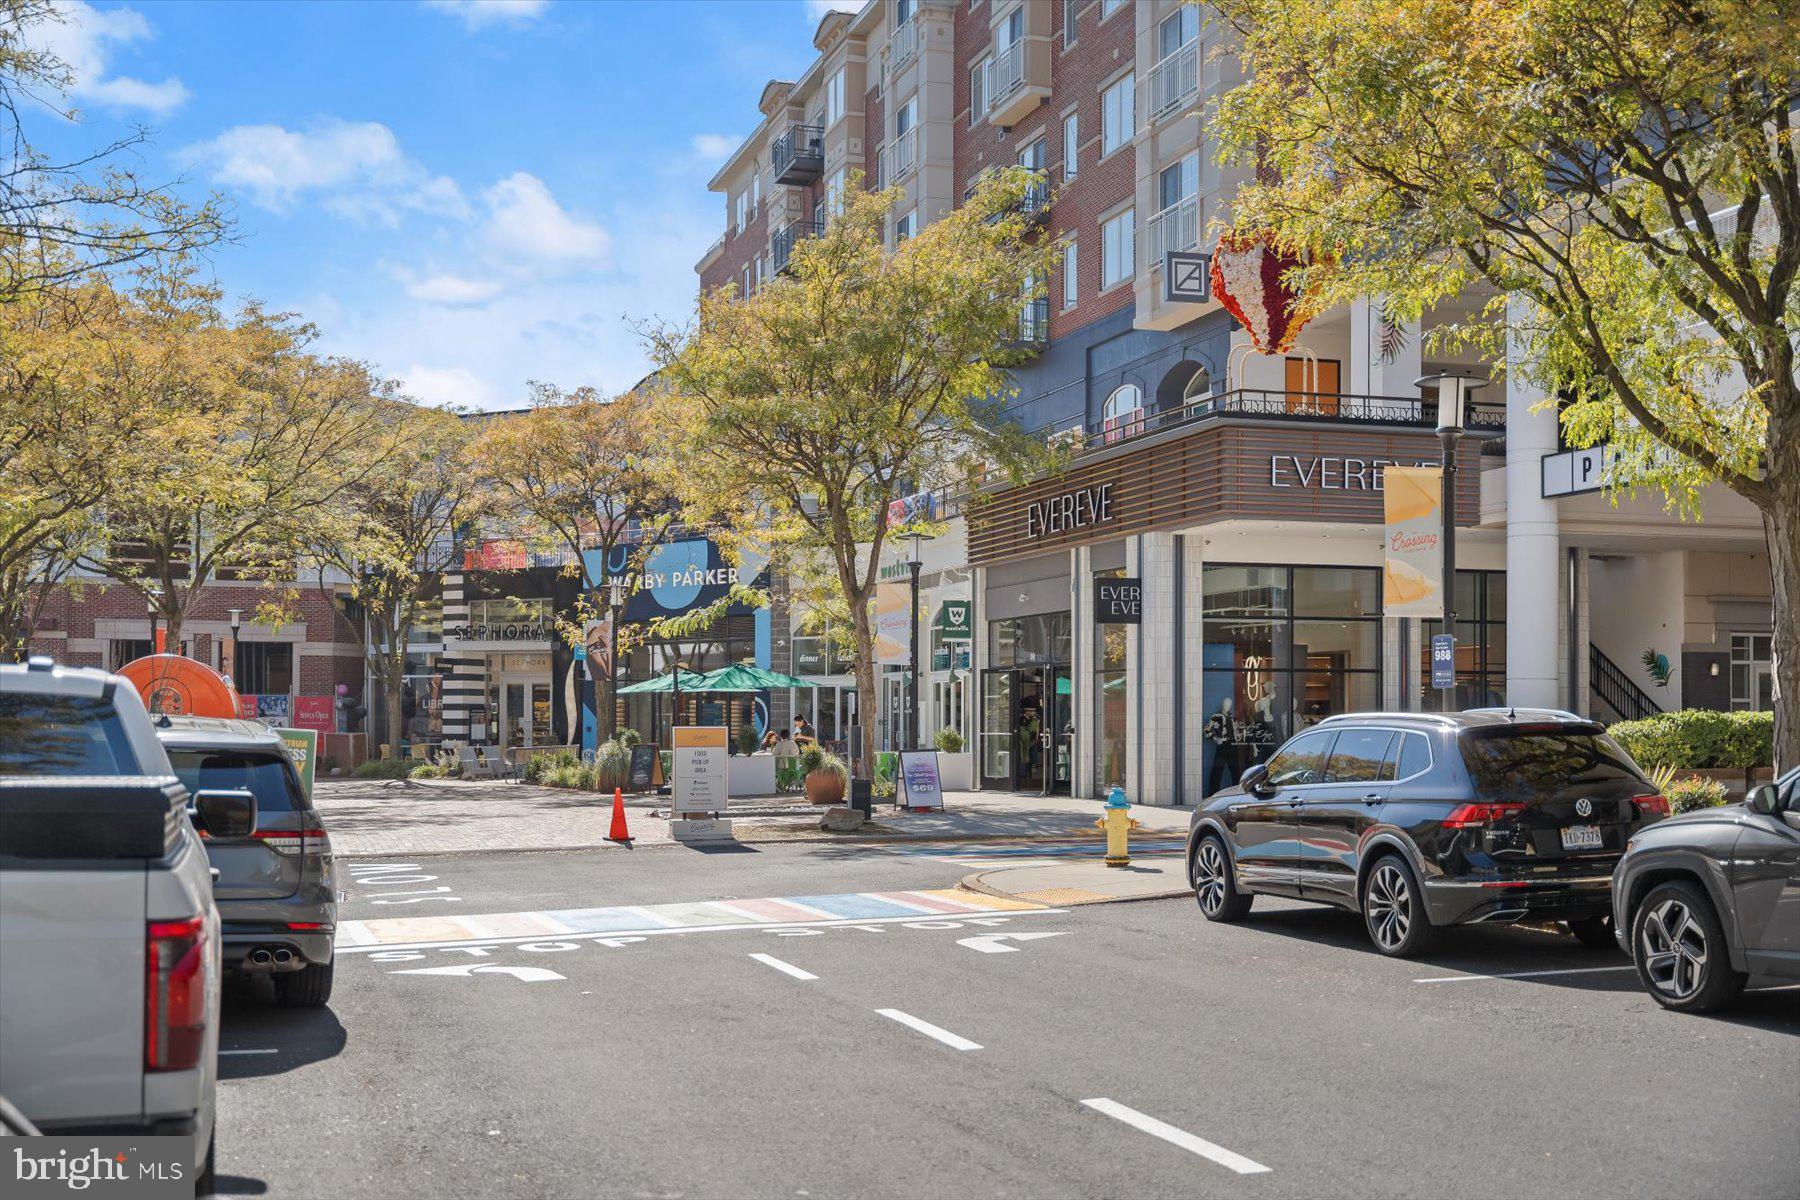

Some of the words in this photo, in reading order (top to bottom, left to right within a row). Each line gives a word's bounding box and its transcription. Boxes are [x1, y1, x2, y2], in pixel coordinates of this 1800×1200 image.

[1271, 455, 1440, 491] EVERE
[1027, 483, 1114, 539] EVEREVE
[1390, 531, 1439, 552] Crossing
[672, 567, 739, 587] PARKER
[1100, 586, 1140, 600] EVER
[1111, 600, 1140, 615] EVE
[454, 624, 546, 640] SEPHORA
[800, 653, 819, 663] dinner
[1435, 650, 1451, 661] 988
[760, 917, 1011, 938] STOP
[366, 935, 648, 963] STOP
